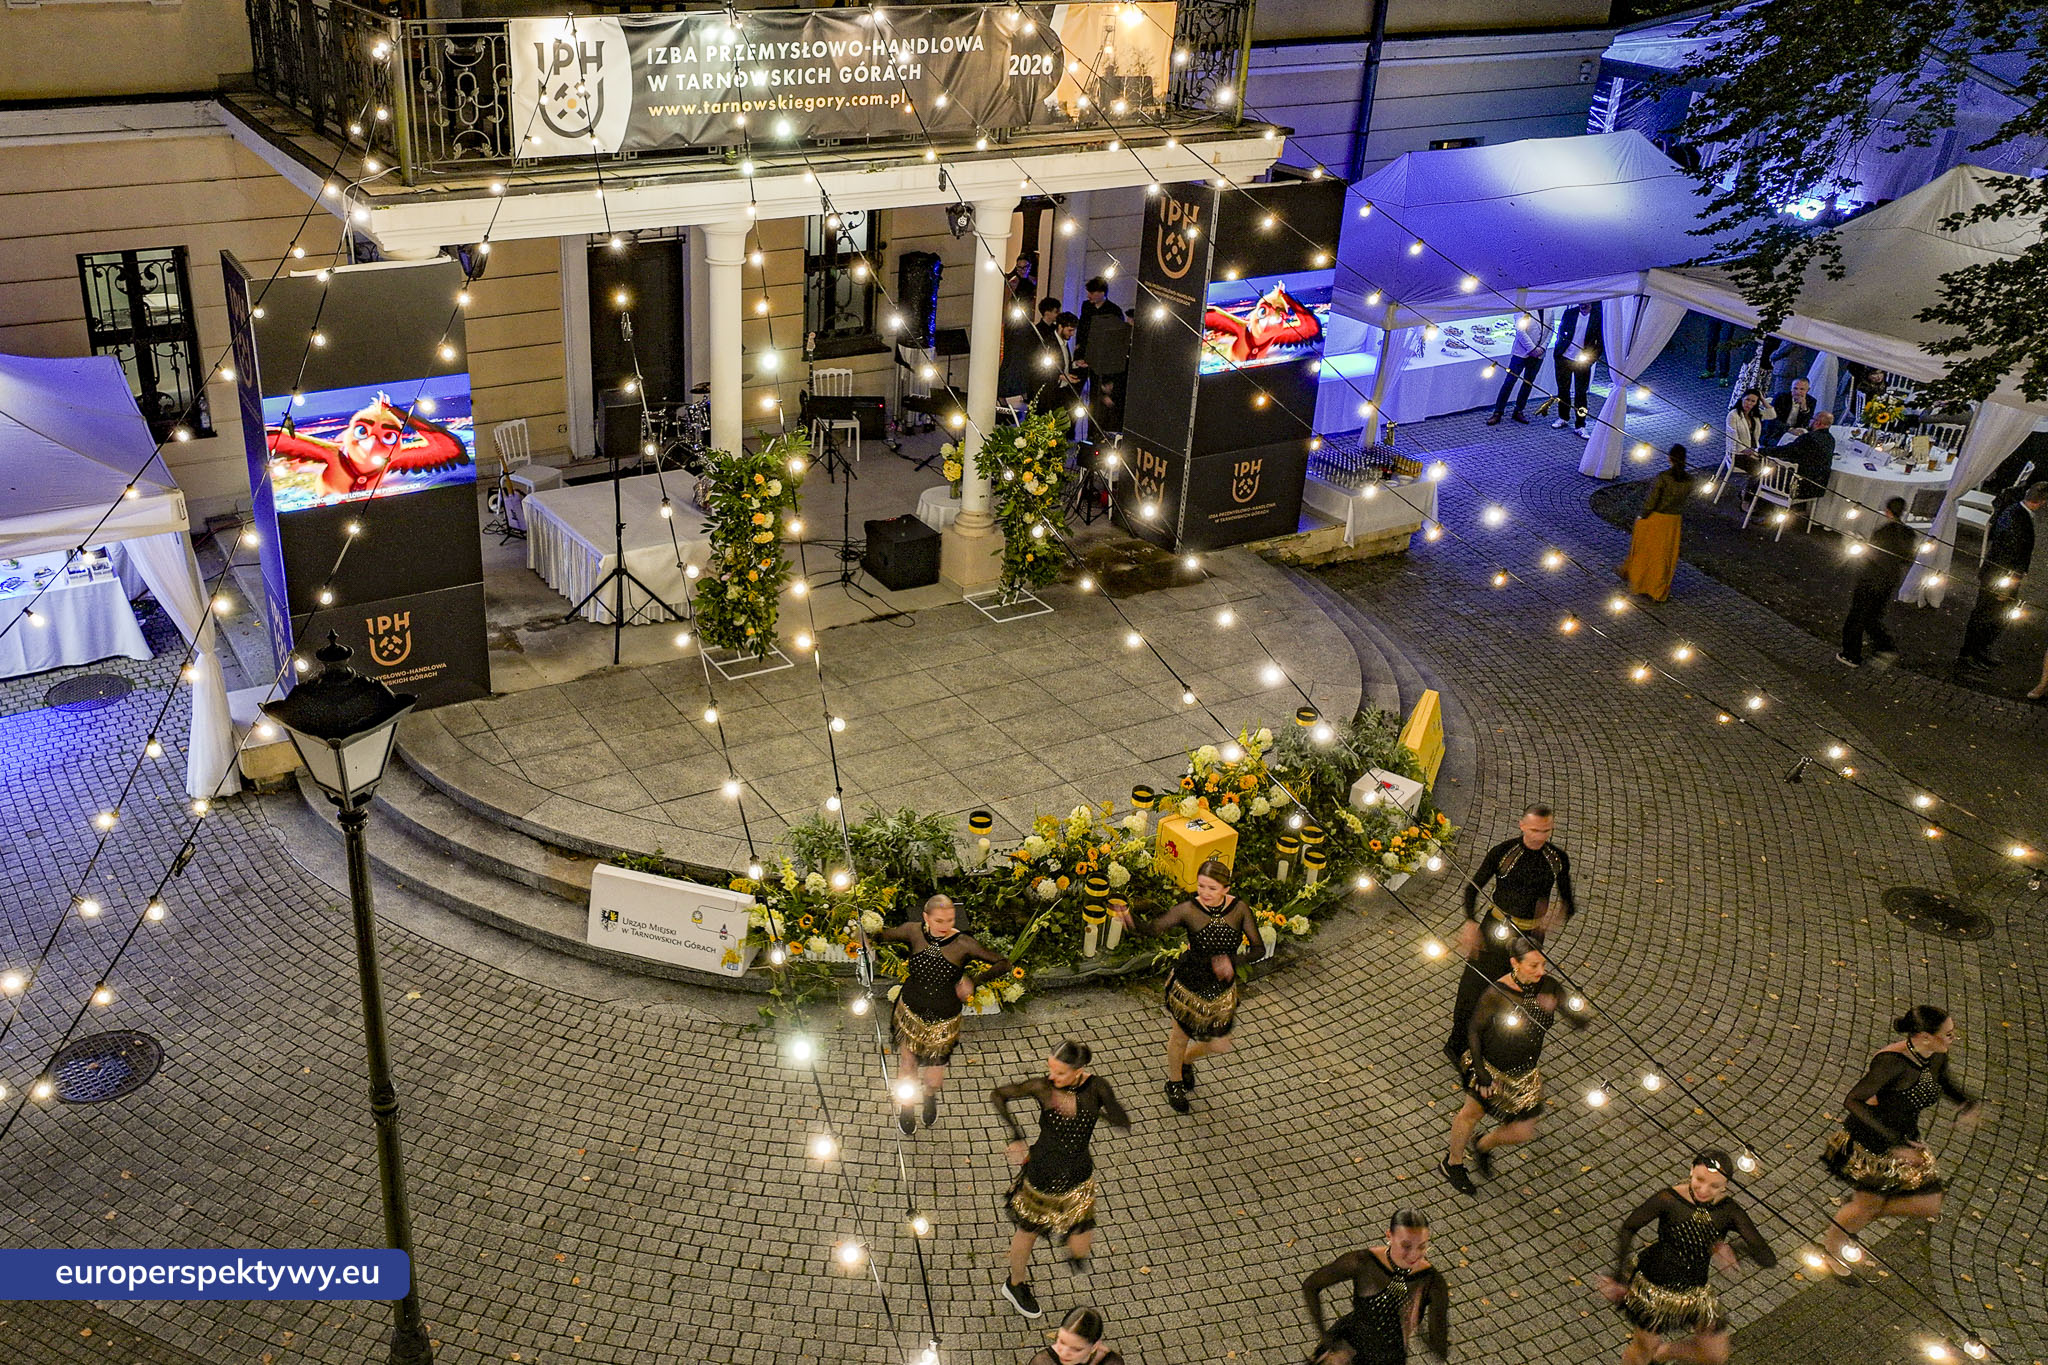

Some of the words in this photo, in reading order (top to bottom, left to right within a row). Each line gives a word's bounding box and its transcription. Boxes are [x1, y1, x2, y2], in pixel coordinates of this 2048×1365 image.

[533, 40, 605, 75] IPH
[647, 46, 698, 65] IZBA
[706, 35, 984, 63] PRZEMYSŁOWO-HANDLOWA
[647, 75, 669, 91] W
[676, 67, 831, 91] TARNOWSKICH
[839, 60, 922, 84] GÓRACH
[1008, 54, 1054, 76] 2026
[648, 88, 906, 117] www.tarnowskiegory.com.pl
[1159, 196, 1200, 230] IPH
[1136, 447, 1168, 479] IPH
[1234, 458, 1263, 477] IPH
[365, 611, 410, 635] IPH
[373, 662, 447, 681] MYSŁOWO-HANDLOWA
[383, 675, 409, 687] WSKICH
[409, 671, 438, 682] GÓRACH
[622, 917, 647, 930] URZĄD
[648, 923, 677, 936] MIEJSKI
[630, 927, 682, 947] TARNOWSKICH
[684, 940, 717, 954] GÓRACH
